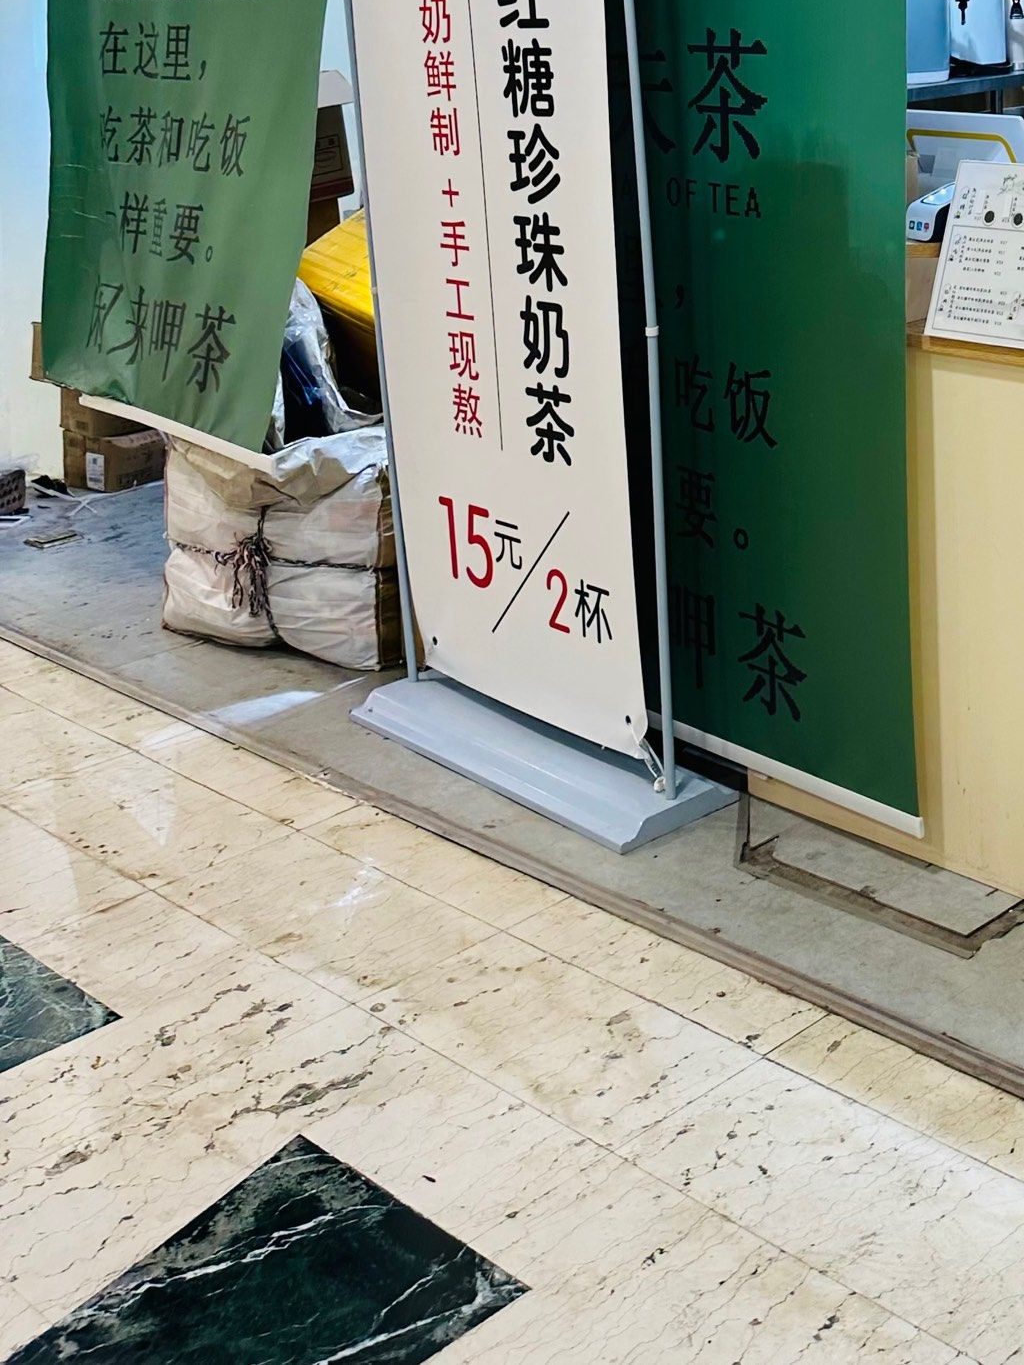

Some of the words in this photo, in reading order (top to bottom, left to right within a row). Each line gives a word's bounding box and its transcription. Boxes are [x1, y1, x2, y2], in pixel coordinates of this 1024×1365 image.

[99, 105, 251, 177] 吃茶和吃饭
[665, 177, 699, 210] OF
[705, 180, 763, 220] TEA
